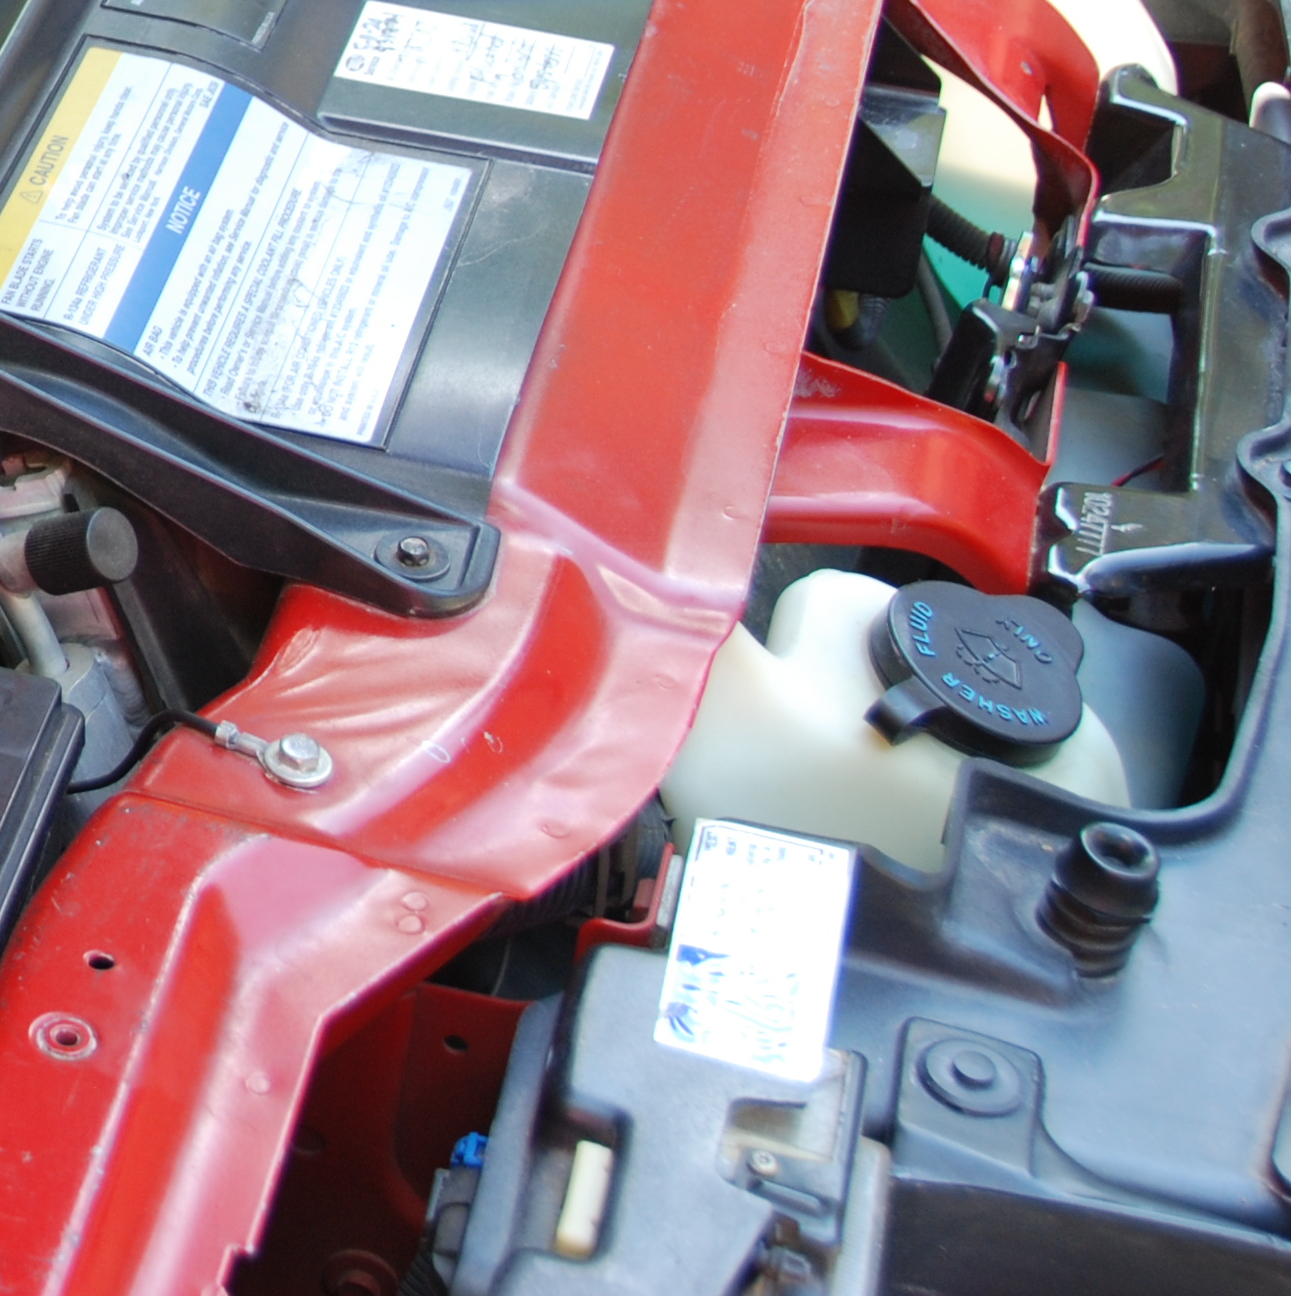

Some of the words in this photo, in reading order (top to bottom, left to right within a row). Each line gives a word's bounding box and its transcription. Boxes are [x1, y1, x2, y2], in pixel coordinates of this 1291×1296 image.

[28, 133, 69, 186] CAUTION
[165, 186, 201, 233] NOTICE
[239, 194, 256, 217] Manual
[276, 188, 301, 228] PROCEDURE
[210, 231, 225, 245] bag
[228, 218, 246, 241] Service
[201, 253, 213, 263] an
[206, 243, 218, 254] air
[255, 243, 277, 275] COOLANT
[0, 289, 15, 304] FAN
[8, 265, 28, 289] BLADE
[21, 237, 42, 264] STARTS
[16, 275, 39, 307] WITHOUT
[33, 248, 53, 274] ENGINE
[75, 247, 107, 296] REFRIGERANT
[78, 298, 99, 325] UNDER
[91, 280, 108, 299] HIGH
[100, 243, 126, 281] PRESSURE
[195, 262, 209, 277] with
[180, 277, 204, 309] equipped
[195, 281, 217, 313] unwanted
[242, 276, 263, 305] SPECIAL
[177, 308, 188, 316] is
[184, 335, 211, 374] procedures
[202, 312, 219, 334] before
[212, 277, 237, 313] performing
[228, 264, 243, 278] any
[239, 304, 251, 312] A
[148, 326, 163, 342] BAG
[166, 315, 185, 340] vehicle
[183, 312, 205, 340] prevent
[223, 311, 248, 348] REQUIRES
[141, 341, 156, 357] AIR
[158, 339, 174, 355] This
[171, 354, 184, 364] To
[175, 338, 193, 356] help
[209, 347, 232, 380] VEHICLE
[202, 378, 218, 397] THIS
[1075, 491, 1113, 556] 10247777
[907, 599, 937, 658] FLUID
[994, 617, 1053, 665] ONLY
[940, 670, 1048, 727] WASHER
